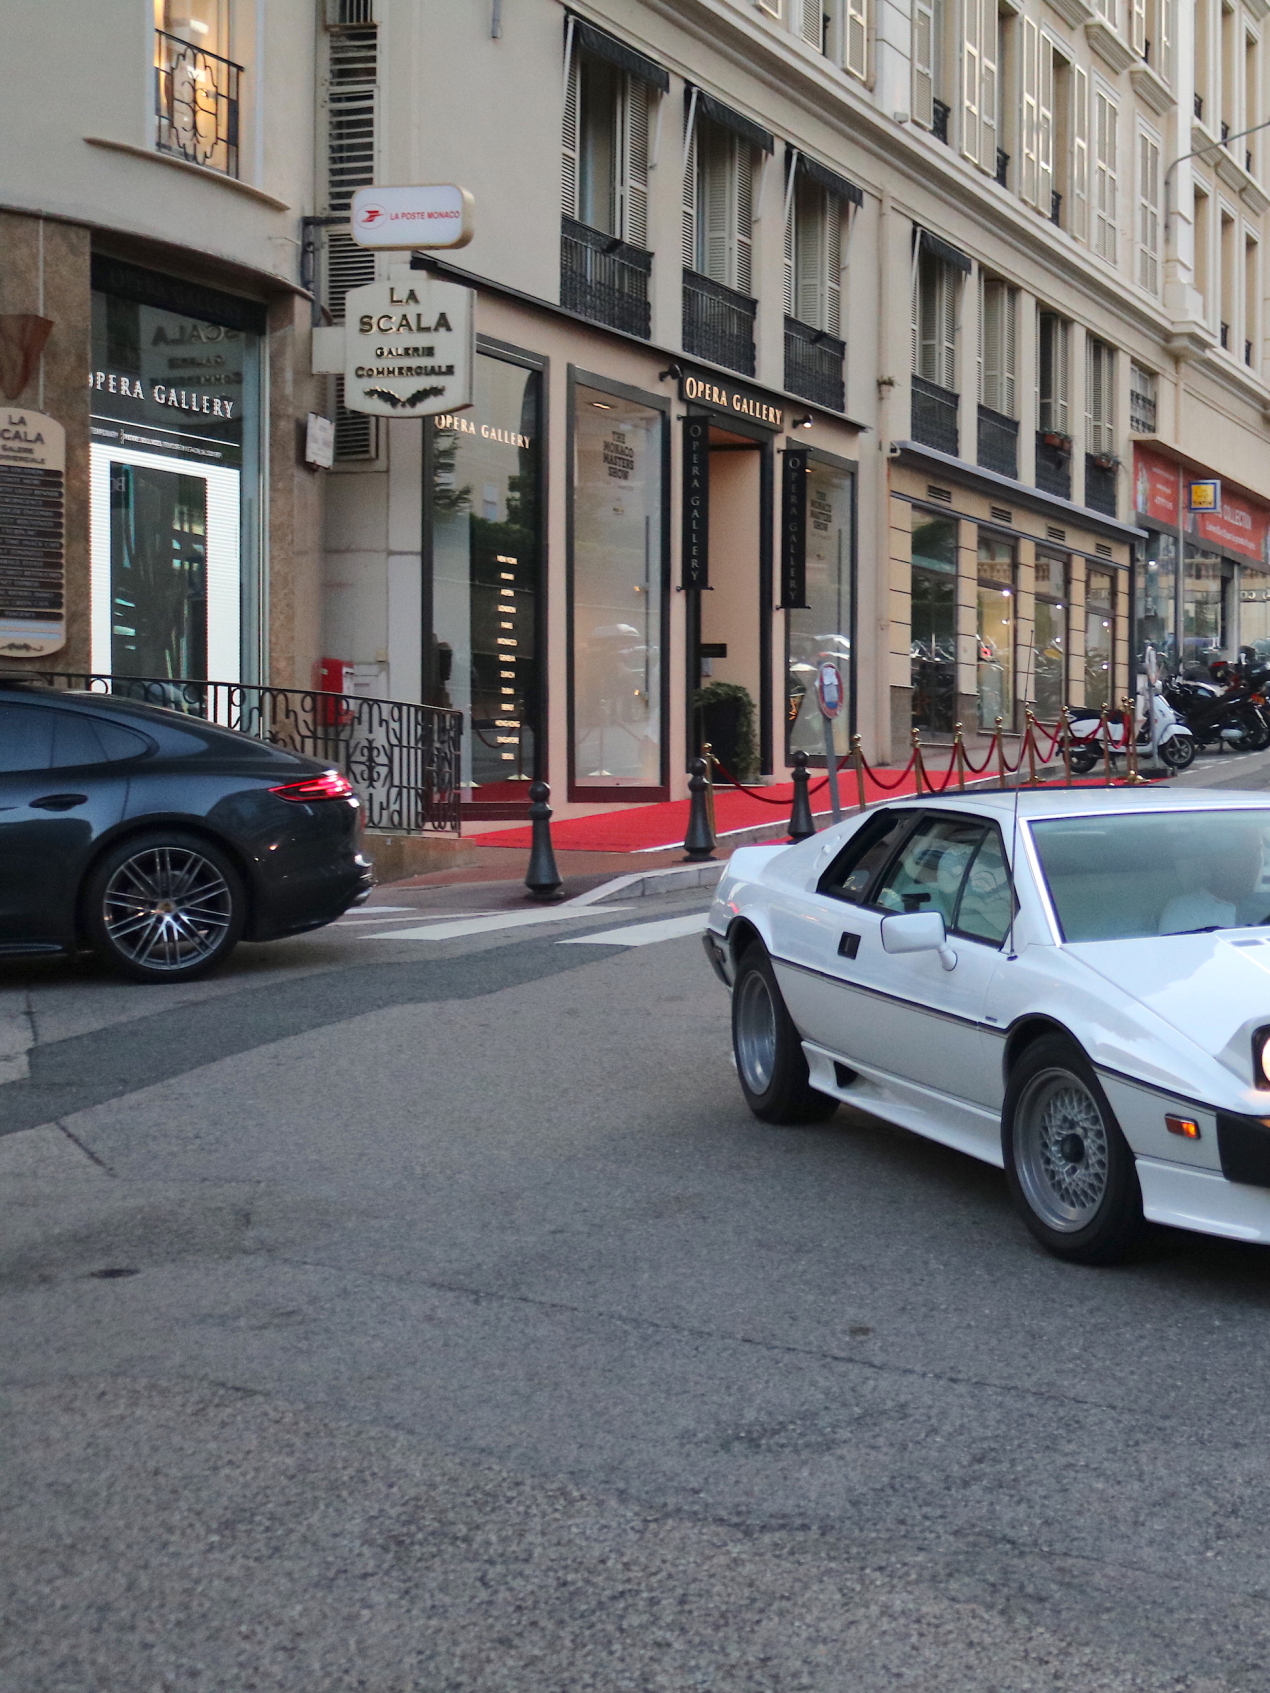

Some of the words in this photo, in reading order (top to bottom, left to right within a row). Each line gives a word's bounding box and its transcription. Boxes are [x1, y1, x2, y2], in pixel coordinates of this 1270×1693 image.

[401, 211, 425, 220] POSTE
[427, 210, 460, 219] MONACO
[389, 287, 420, 306] LA
[358, 312, 453, 334] SCALA
[375, 346, 435, 359] GALERIE
[355, 364, 455, 379] COMMERCIALE
[153, 385, 234, 419] GALLERY
[686, 377, 729, 407] OPERA
[732, 394, 782, 426] GALLERY
[8, 414, 27, 426] LA
[0, 428, 45, 445] CALA
[434, 414, 477, 435] OPERA
[481, 424, 531, 449] GALLERY
[690, 425, 702, 488] OPERA
[691, 496, 701, 581] GALLERY
